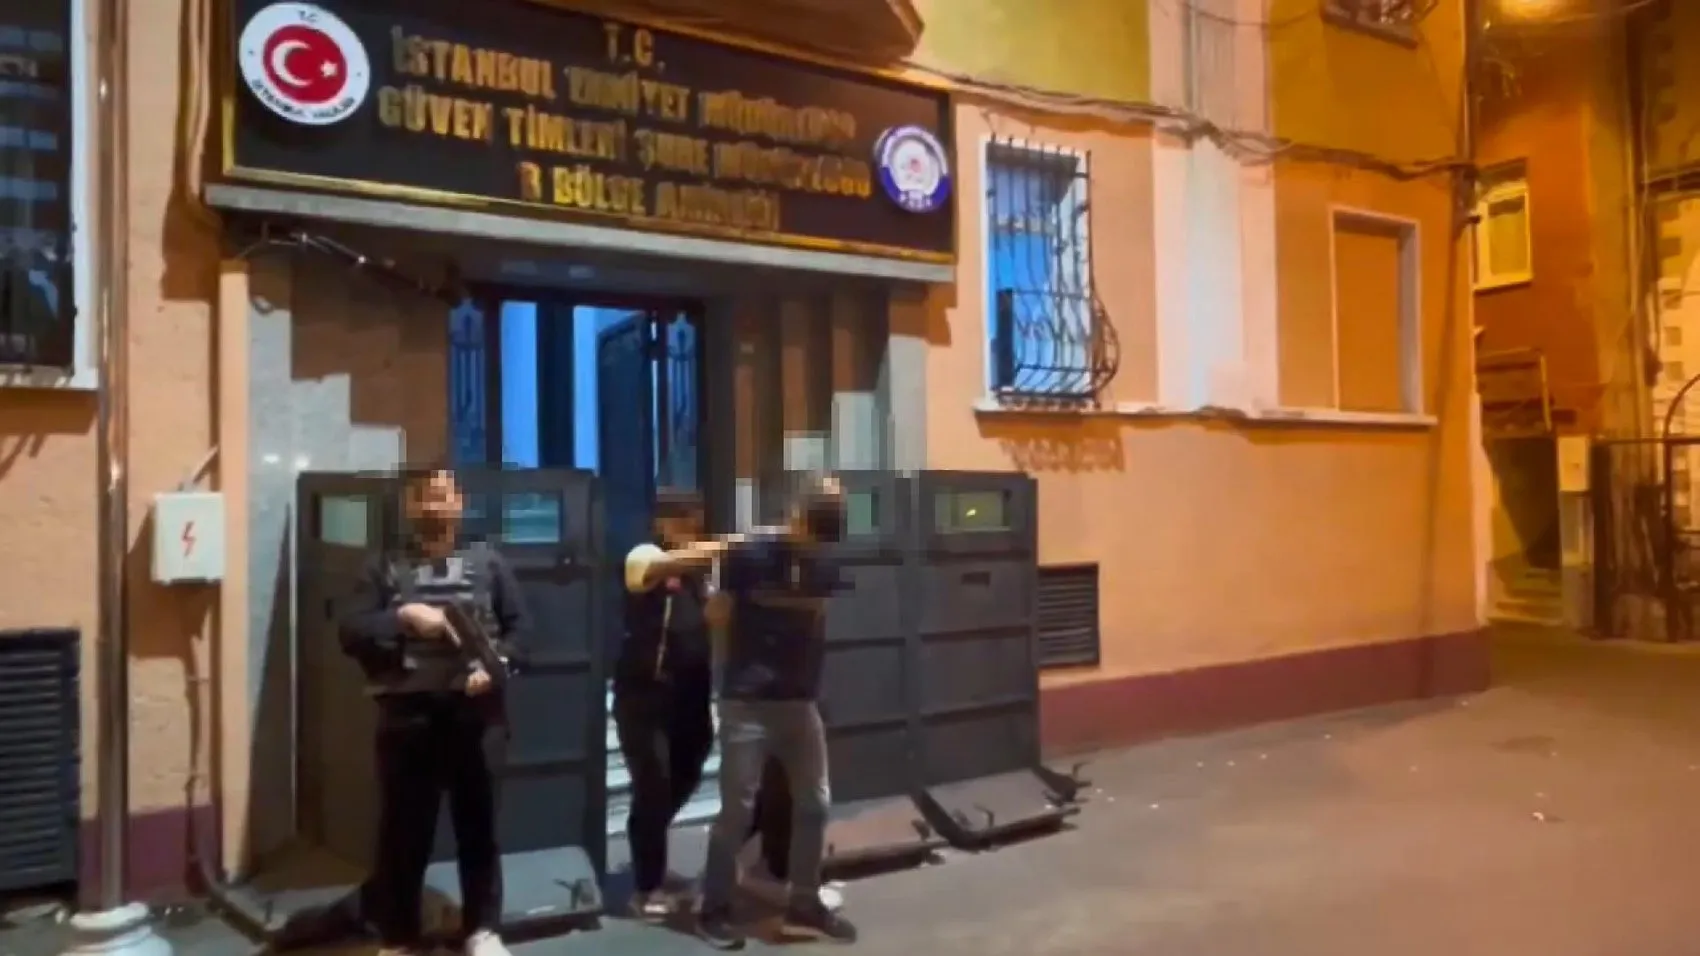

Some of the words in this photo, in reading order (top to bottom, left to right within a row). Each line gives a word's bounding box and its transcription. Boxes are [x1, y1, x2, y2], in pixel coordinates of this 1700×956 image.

[391, 25, 556, 99] İSTANBUL
[563, 65, 691, 119] İYET
[378, 84, 493, 144] GÜVEN
[552, 164, 646, 216] BÖLGE
